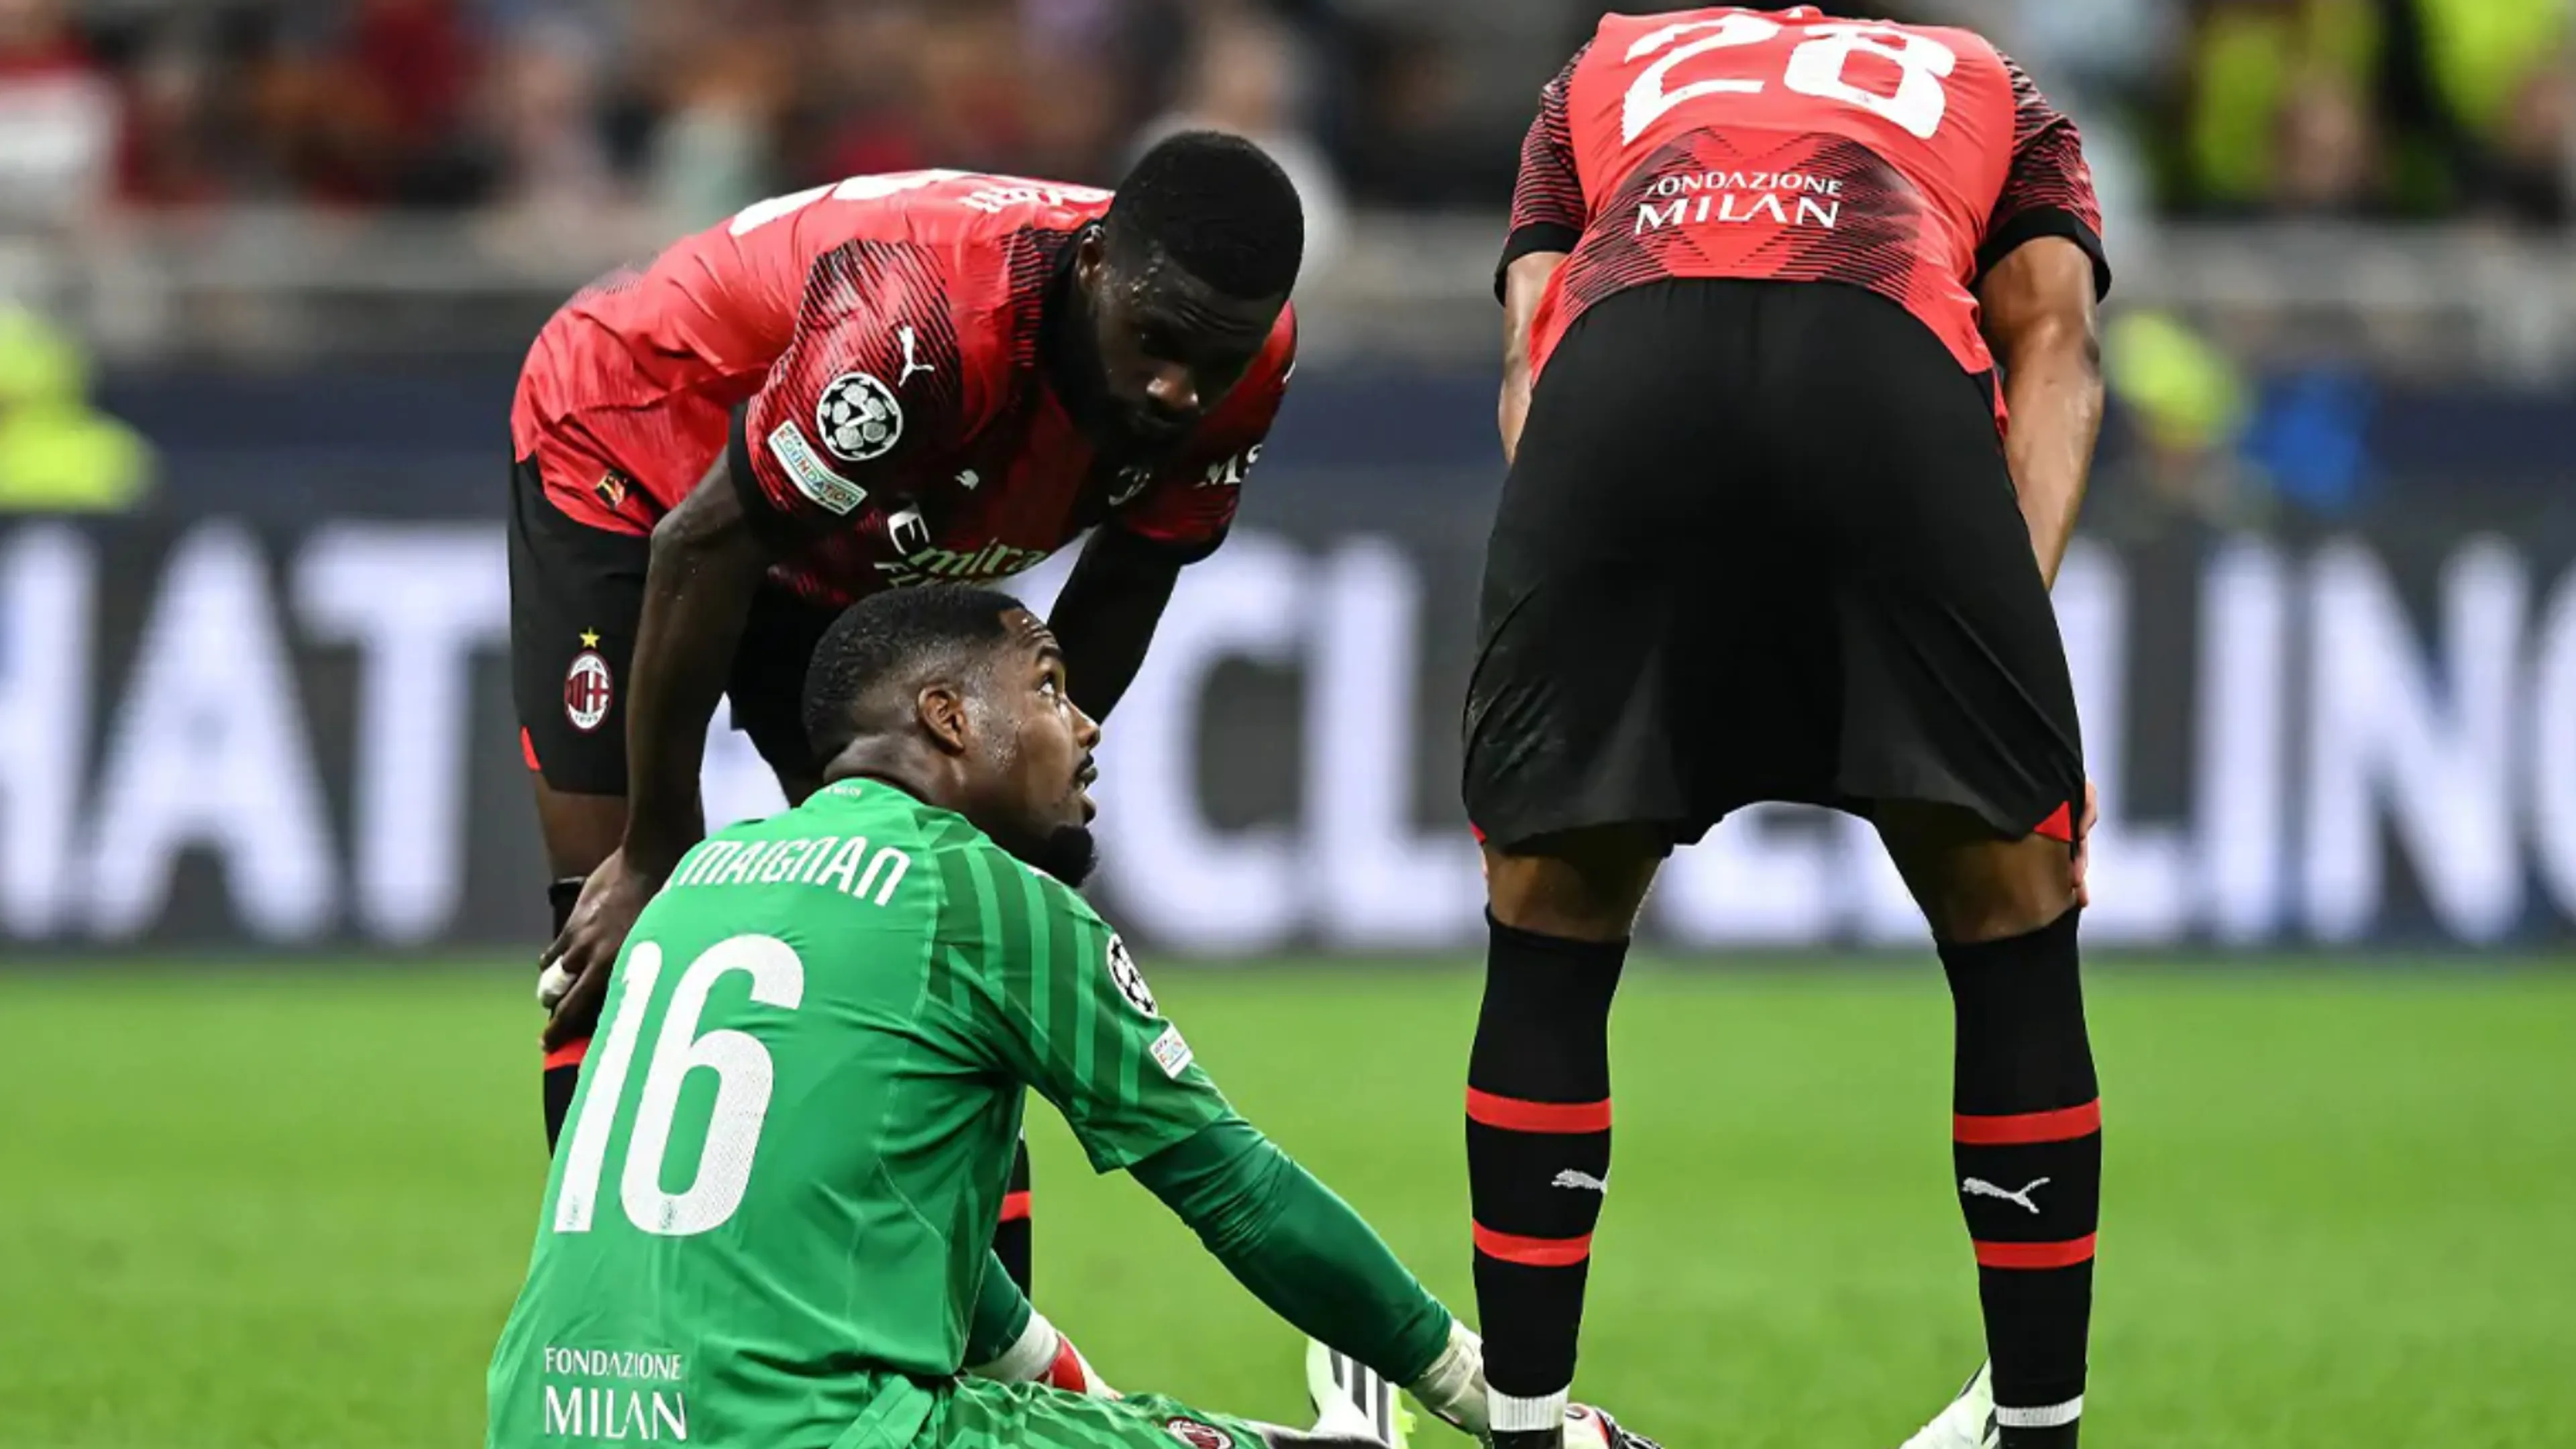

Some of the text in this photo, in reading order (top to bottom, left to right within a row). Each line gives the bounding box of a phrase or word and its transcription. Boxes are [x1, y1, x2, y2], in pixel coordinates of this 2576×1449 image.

[1622, 10, 1956, 145] 28
[1635, 193, 1840, 234] MILAN
[678, 835, 911, 907] MAIGNAN
[553, 932, 804, 1236] 16
[544, 1347, 682, 1381] FONDAZIONE
[545, 1384, 688, 1442] MILAN
